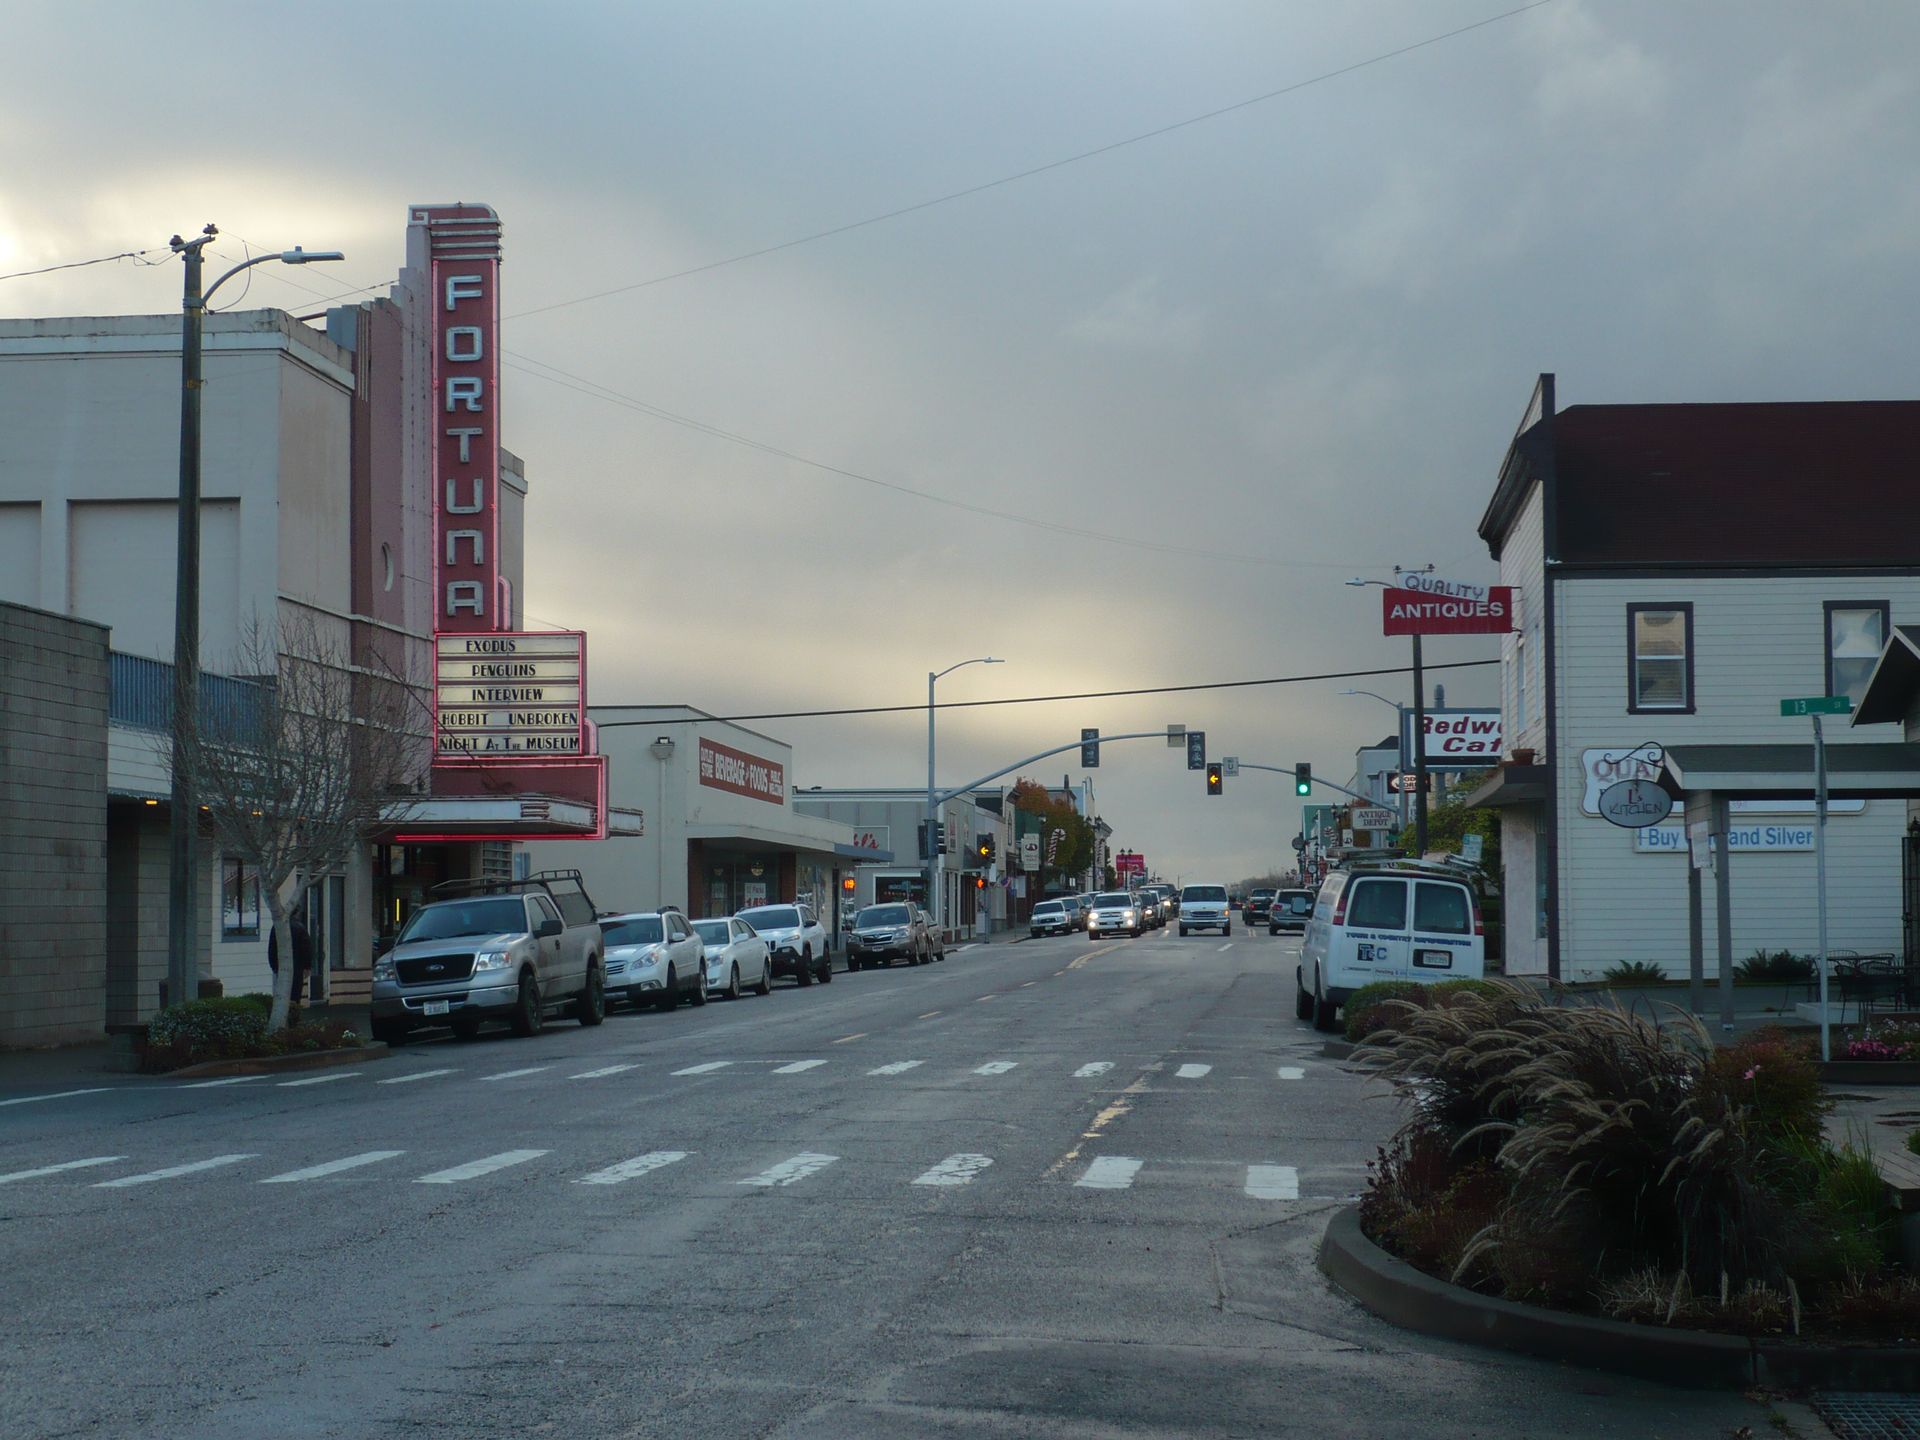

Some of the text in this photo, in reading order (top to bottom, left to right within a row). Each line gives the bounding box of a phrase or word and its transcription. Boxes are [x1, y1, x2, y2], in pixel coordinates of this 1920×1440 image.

[445, 274, 484, 617] FORTUNA
[1405, 574, 1484, 599] QUALITY
[1390, 602, 1504, 619] ANTIQUES
[466, 640, 516, 652] EXODUS
[472, 664, 536, 677] PENGUINS
[472, 688, 544, 701] INTERVIEW
[1794, 700, 1806, 713] 13
[442, 712, 578, 725] HOBBIT UNBROKEN
[439, 738, 479, 750] NIGHT
[526, 737, 580, 750] MUSEUM
[1609, 802, 1662, 816] KITCHEN
[1648, 828, 1679, 849] Buy
[1729, 827, 1760, 846] and
[1765, 827, 1812, 846] Silver
